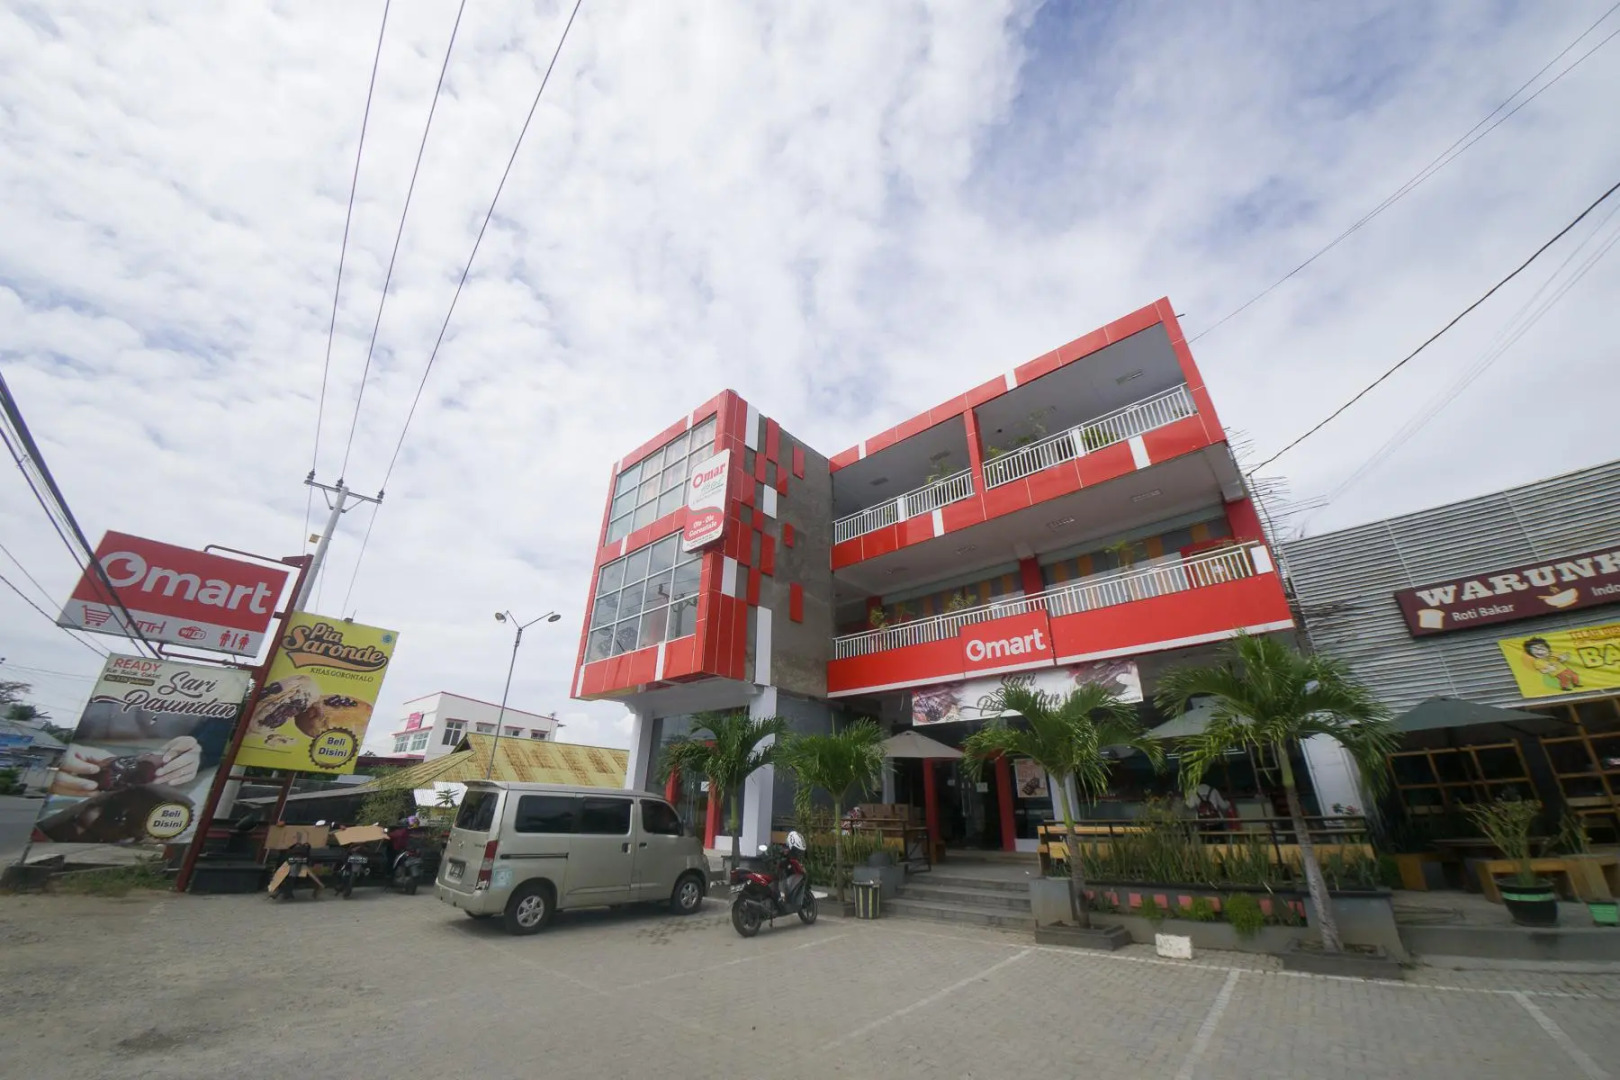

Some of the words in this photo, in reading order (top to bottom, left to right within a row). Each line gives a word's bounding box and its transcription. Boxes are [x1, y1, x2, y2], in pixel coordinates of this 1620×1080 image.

[99, 551, 272, 614] Omart
[1452, 609, 1478, 621] Roti
[1478, 604, 1514, 617] Bakar
[310, 622, 344, 643] Pia
[281, 625, 388, 664] Saronde
[966, 628, 1046, 662] Omart
[113, 657, 163, 673] READY
[310, 667, 330, 677] KHAS
[330, 670, 374, 683] GORONTALO
[158, 671, 218, 698] Sari
[122, 688, 238, 719] Pasundan
[327, 736, 346, 746] Beli
[318, 747, 348, 757] Disini
[161, 809, 181, 818] Beli
[153, 820, 183, 828] Disini
